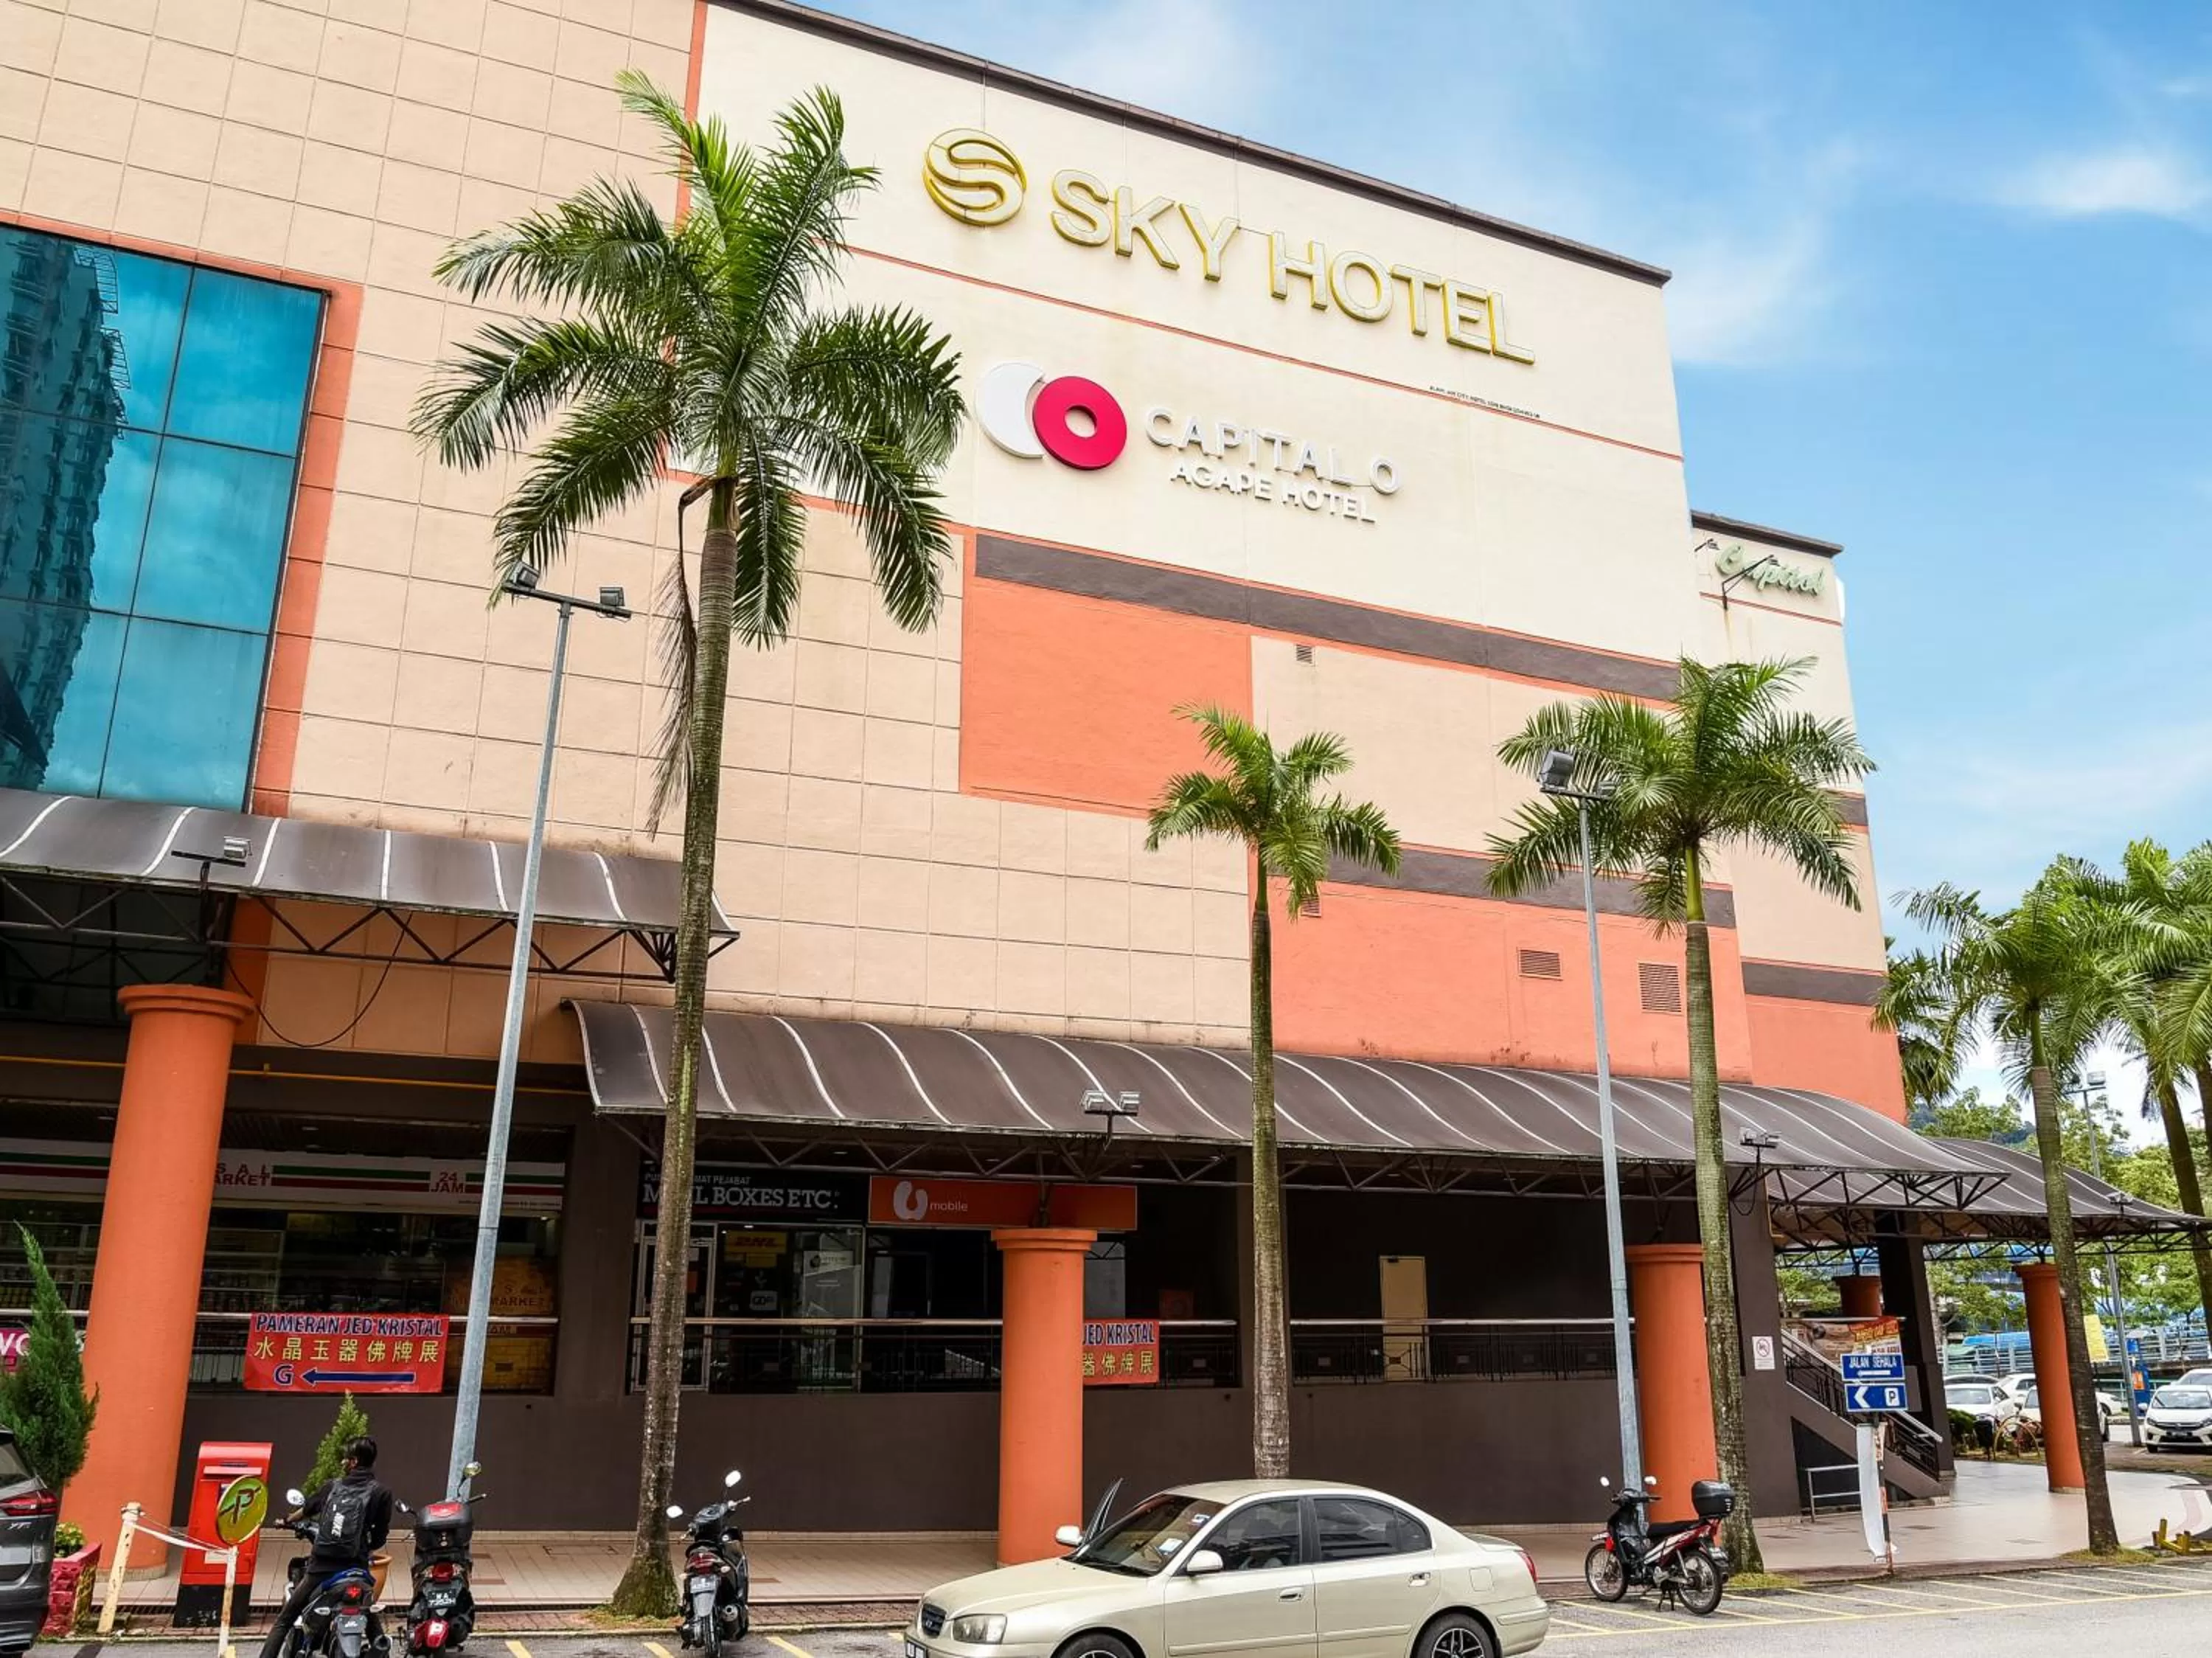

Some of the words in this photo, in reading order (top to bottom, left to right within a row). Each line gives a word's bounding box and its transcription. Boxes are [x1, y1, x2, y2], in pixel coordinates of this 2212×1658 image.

[1051, 168, 1240, 282] SKY
[1268, 231, 1534, 365] HOTEL
[1145, 406, 1357, 488] CAPITAL
[1370, 454, 1402, 495] O
[1170, 460, 1273, 501] AGAPE
[1281, 479, 1377, 523] HOTEL
[214, 1173, 271, 1186] ARKET
[431, 1182, 465, 1193] JAM
[439, 1171, 458, 1182] 24
[642, 1183, 709, 1204] ML
[712, 1186, 785, 1207] BOXES
[930, 1200, 969, 1212] mobile
[255, 1314, 340, 1334] PAMERAN
[342, 1317, 374, 1335] JED
[377, 1318, 444, 1337] KRISTAL
[1106, 1322, 1155, 1345] KRISTAL
[254, 1336, 439, 1363] 水晶玉器佛牌展
[275, 1365, 293, 1384] G
[1888, 1390, 1896, 1405] P
